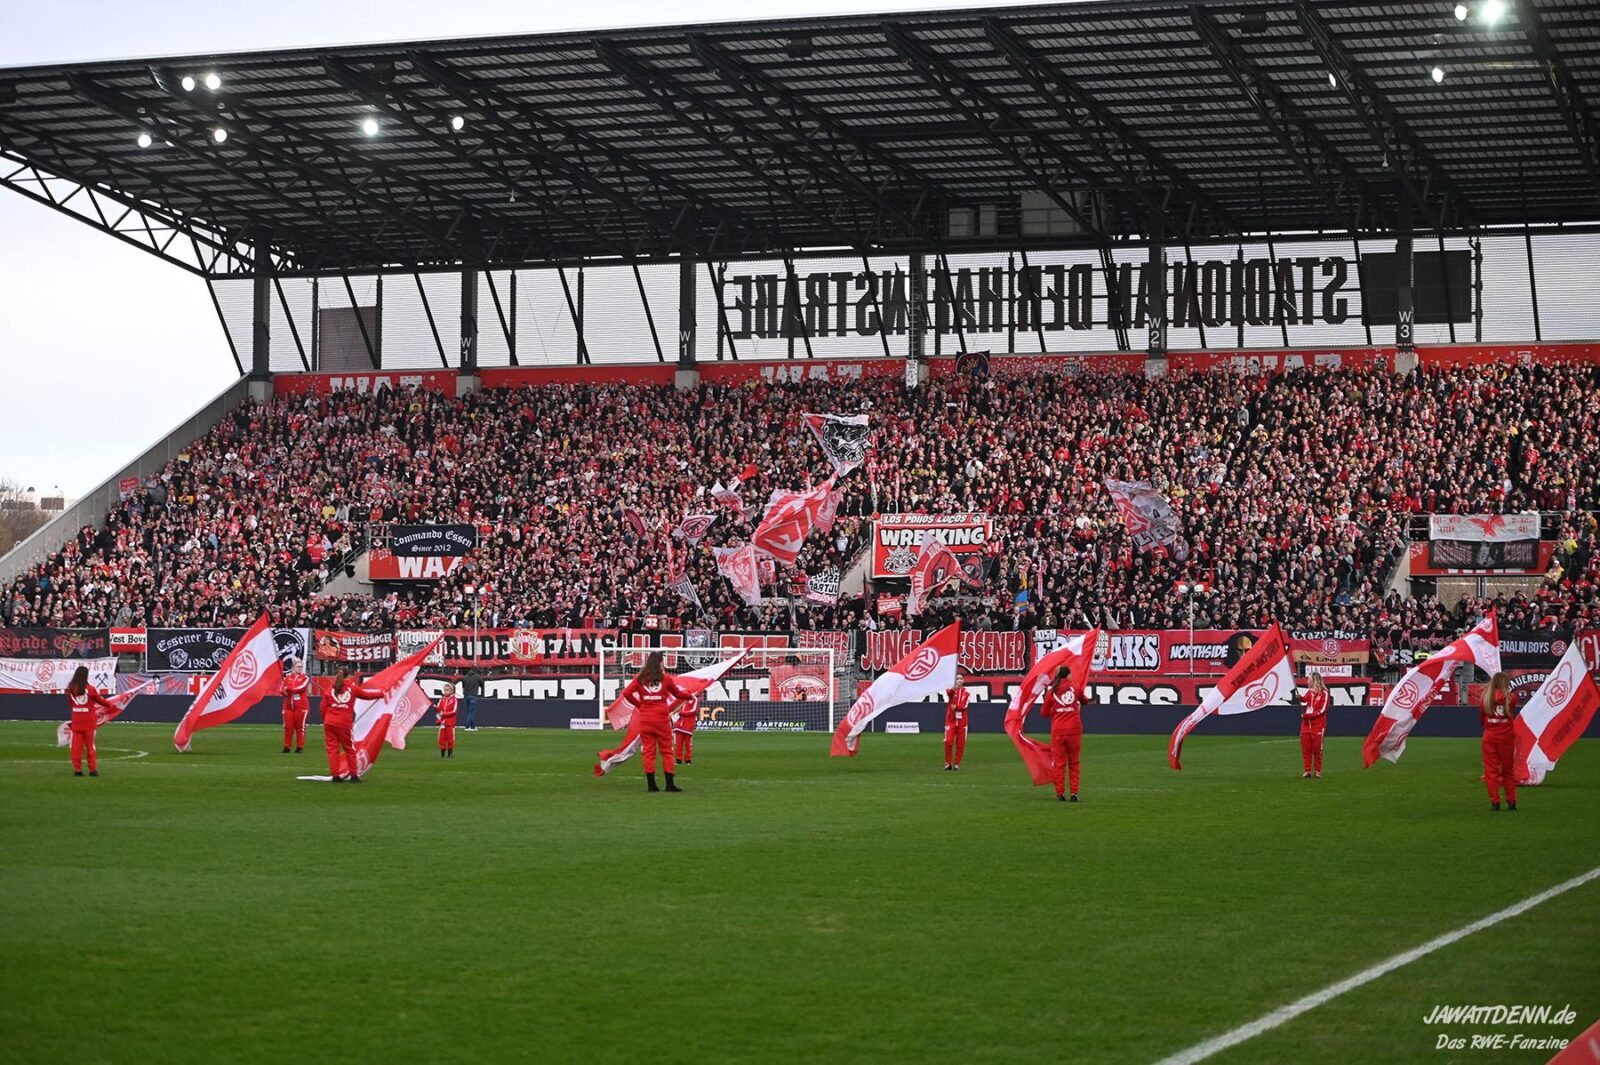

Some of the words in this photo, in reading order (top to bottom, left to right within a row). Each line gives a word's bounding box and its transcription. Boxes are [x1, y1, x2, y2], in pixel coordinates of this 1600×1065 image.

[1148, 317, 1161, 329] W
[1398, 311, 1412, 323] W
[680, 331, 691, 342] W
[1150, 331, 1160, 344] 2
[1400, 325, 1410, 338] 3
[461, 337, 472, 348] W
[445, 530, 473, 548] Essen
[411, 544, 433, 553] Since
[433, 544, 452, 552] 2012
[157, 633, 202, 652] Essener
[205, 630, 239, 649] Löwe
[444, 634, 510, 660] RUDE
[545, 632, 615, 660] FANS
[1528, 641, 1550, 654] BOYS
[346, 646, 391, 661] ESSEN
[1170, 644, 1229, 660] NORTHSIDE
[188, 657, 213, 669] 1980
